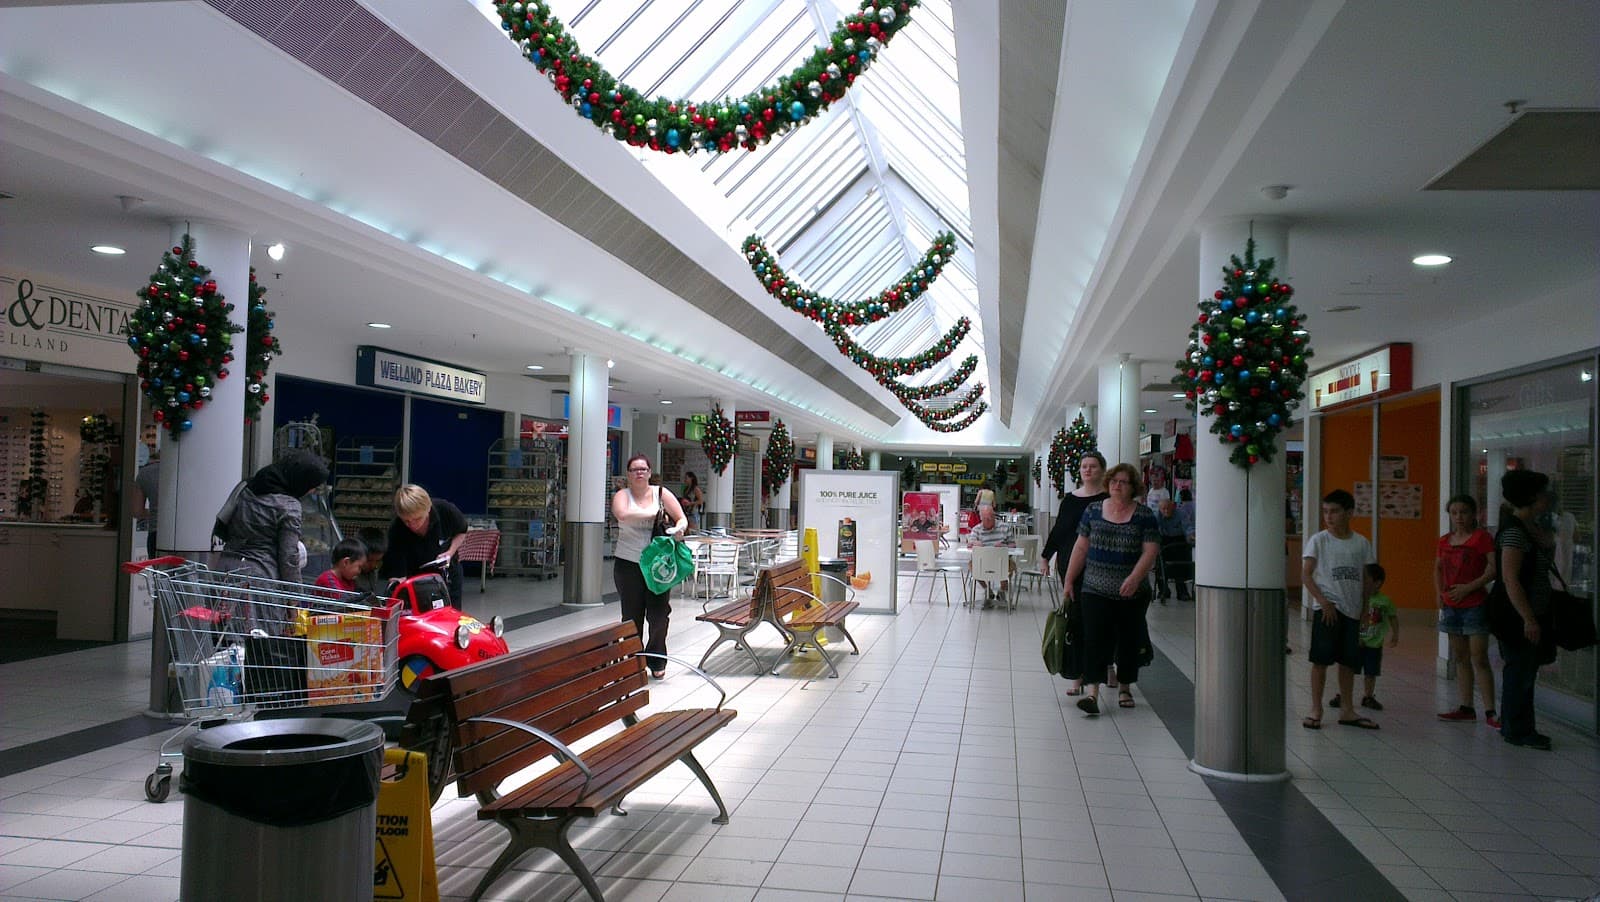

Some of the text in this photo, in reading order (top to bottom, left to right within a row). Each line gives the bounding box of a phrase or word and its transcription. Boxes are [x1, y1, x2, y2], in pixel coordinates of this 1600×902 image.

[48, 296, 132, 336] DENTA
[0, 331, 68, 352] ELLAND
[380, 360, 483, 396] WELLAND PLAZA BAKERY
[839, 491, 857, 499] PURE
[376, 816, 408, 826] TION
